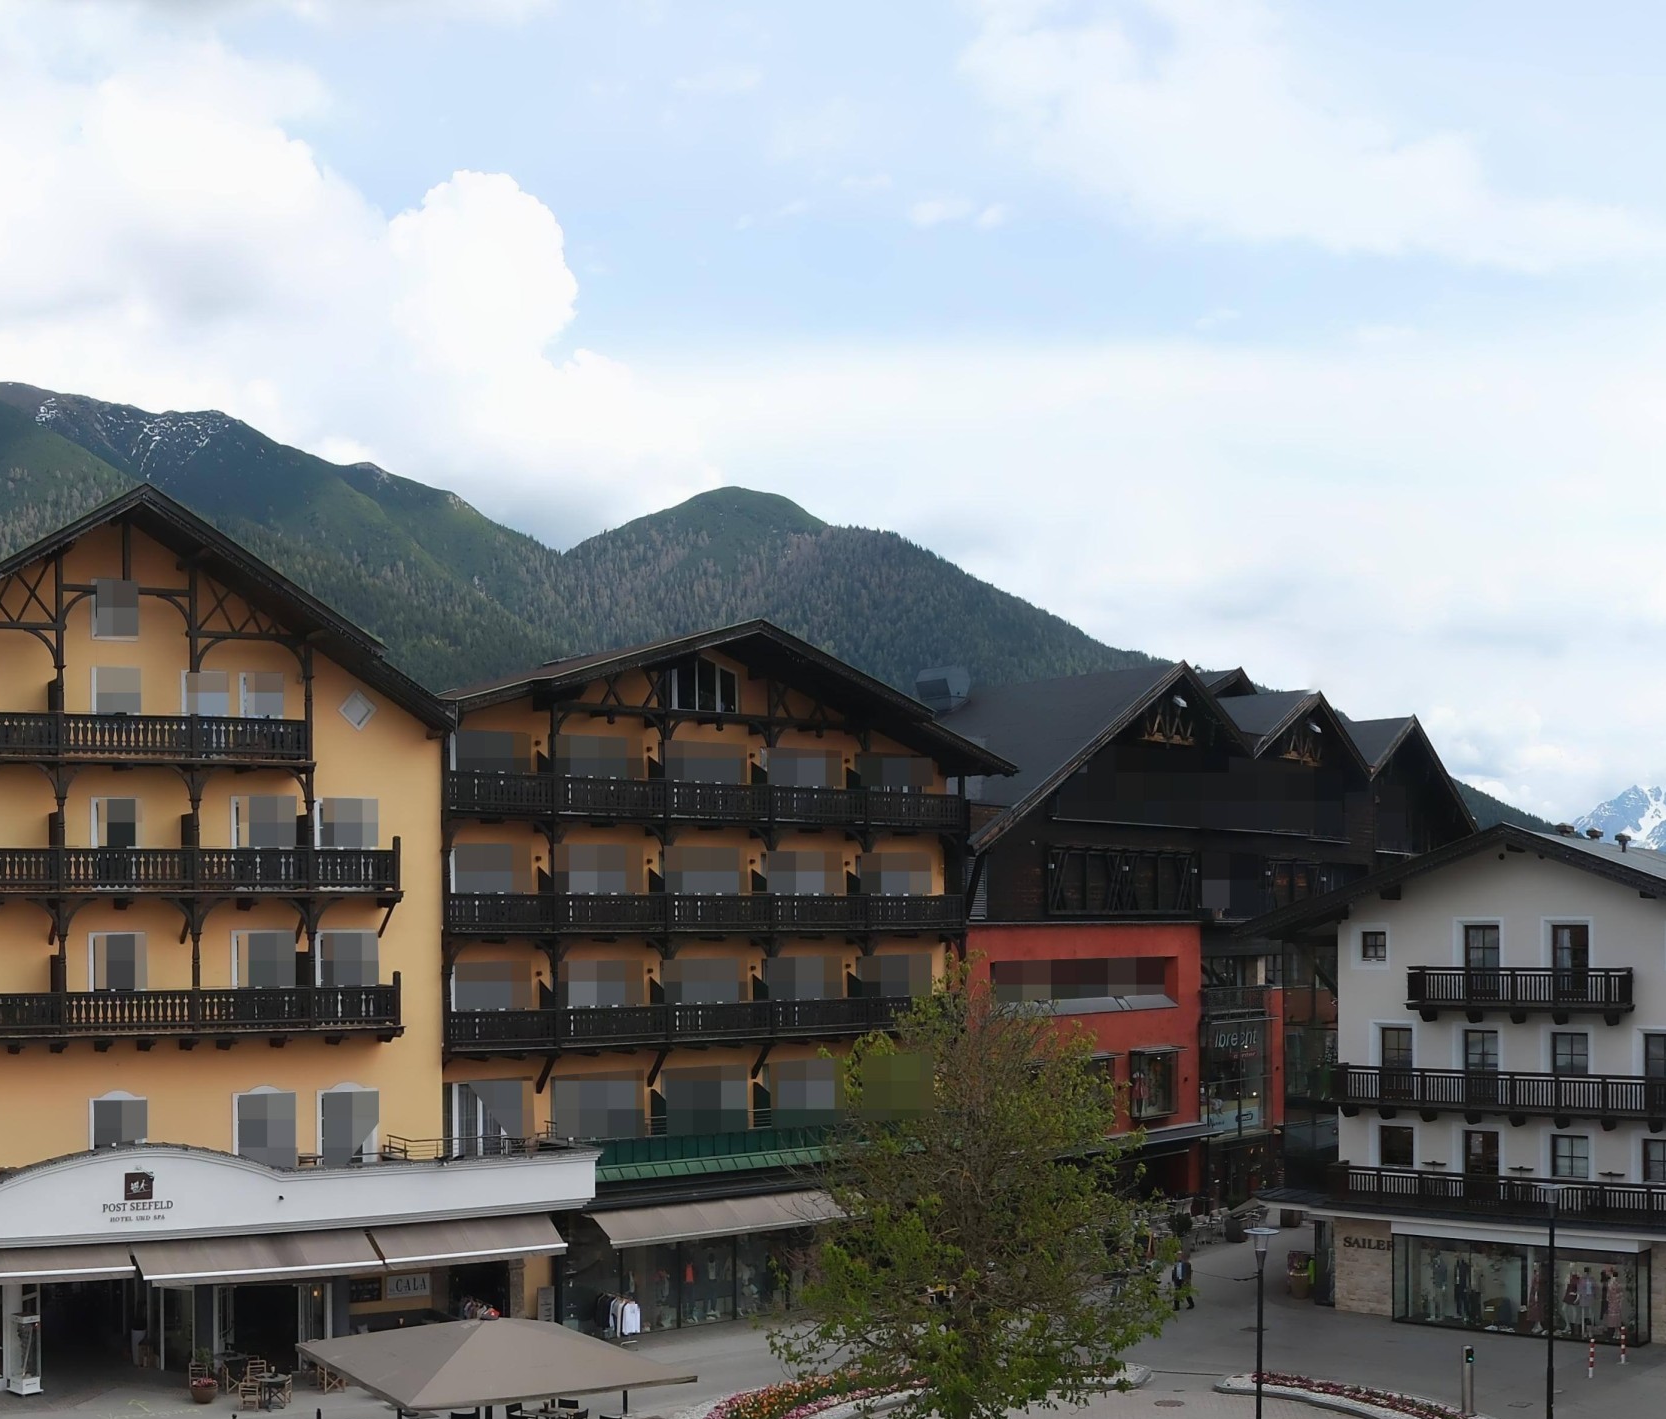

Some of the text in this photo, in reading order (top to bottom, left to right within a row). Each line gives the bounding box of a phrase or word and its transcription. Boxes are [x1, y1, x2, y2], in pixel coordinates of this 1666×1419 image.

[102, 1201, 174, 1213] POST SEEFELD
[395, 1276, 427, 1292] CALA
